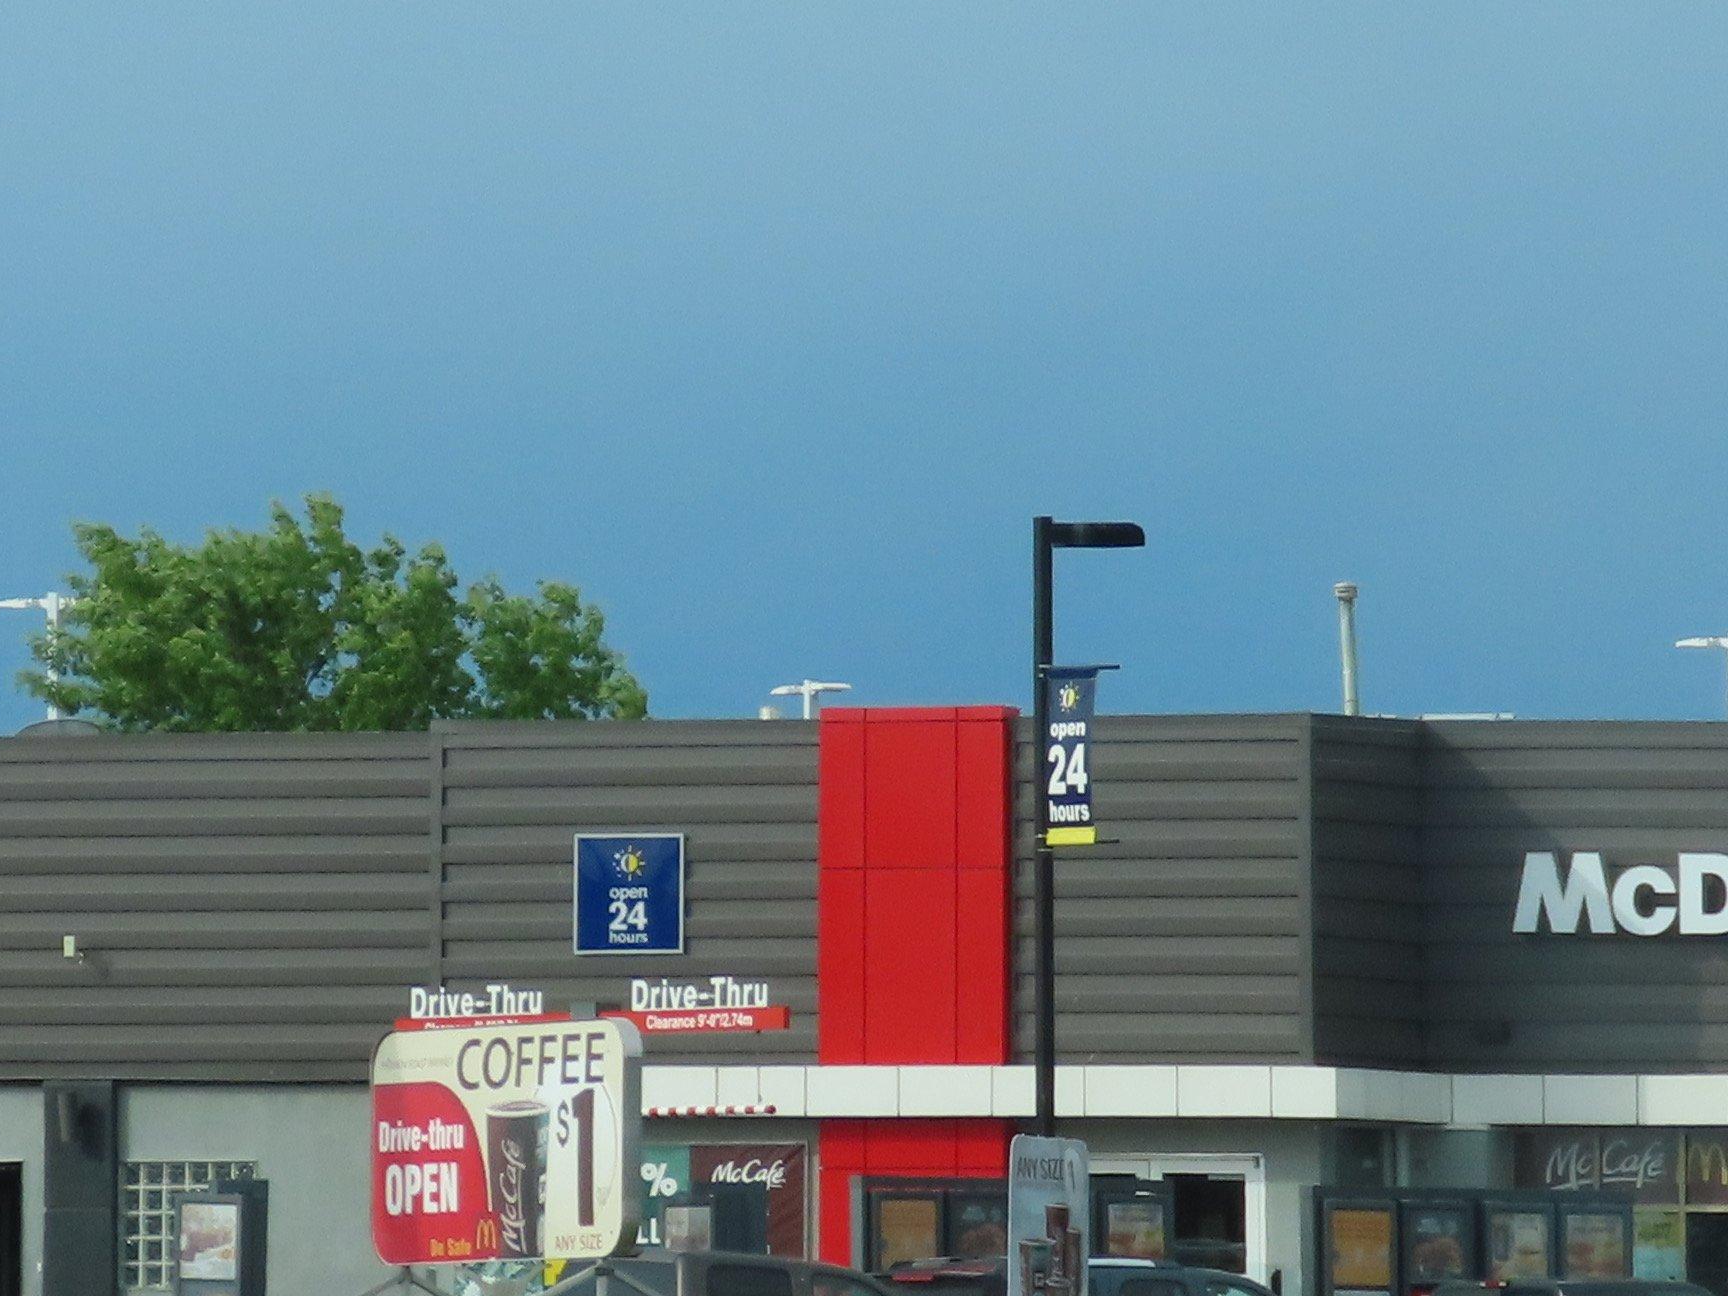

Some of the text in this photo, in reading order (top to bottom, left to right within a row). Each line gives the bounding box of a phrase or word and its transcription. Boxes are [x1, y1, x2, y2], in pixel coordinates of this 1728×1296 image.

[1049, 721, 1086, 740] open
[1047, 743, 1088, 796] 24
[1049, 800, 1091, 823] hours
[609, 886, 648, 901] open
[608, 902, 648, 931] 24
[609, 931, 648, 944] hours
[410, 984, 542, 1019] Drive-Thru
[630, 975, 769, 1011] Drive-Thru
[646, 1014, 697, 1030] Clearance
[457, 1031, 606, 1091] COFFEE
[378, 1118, 465, 1153] Drive-thru
[1016, 1157, 1039, 1180] ANY
[1040, 1156, 1064, 1181] SIZE
[385, 1161, 459, 1216] OPEN
[554, 1234, 603, 1252] ANY SIZE
